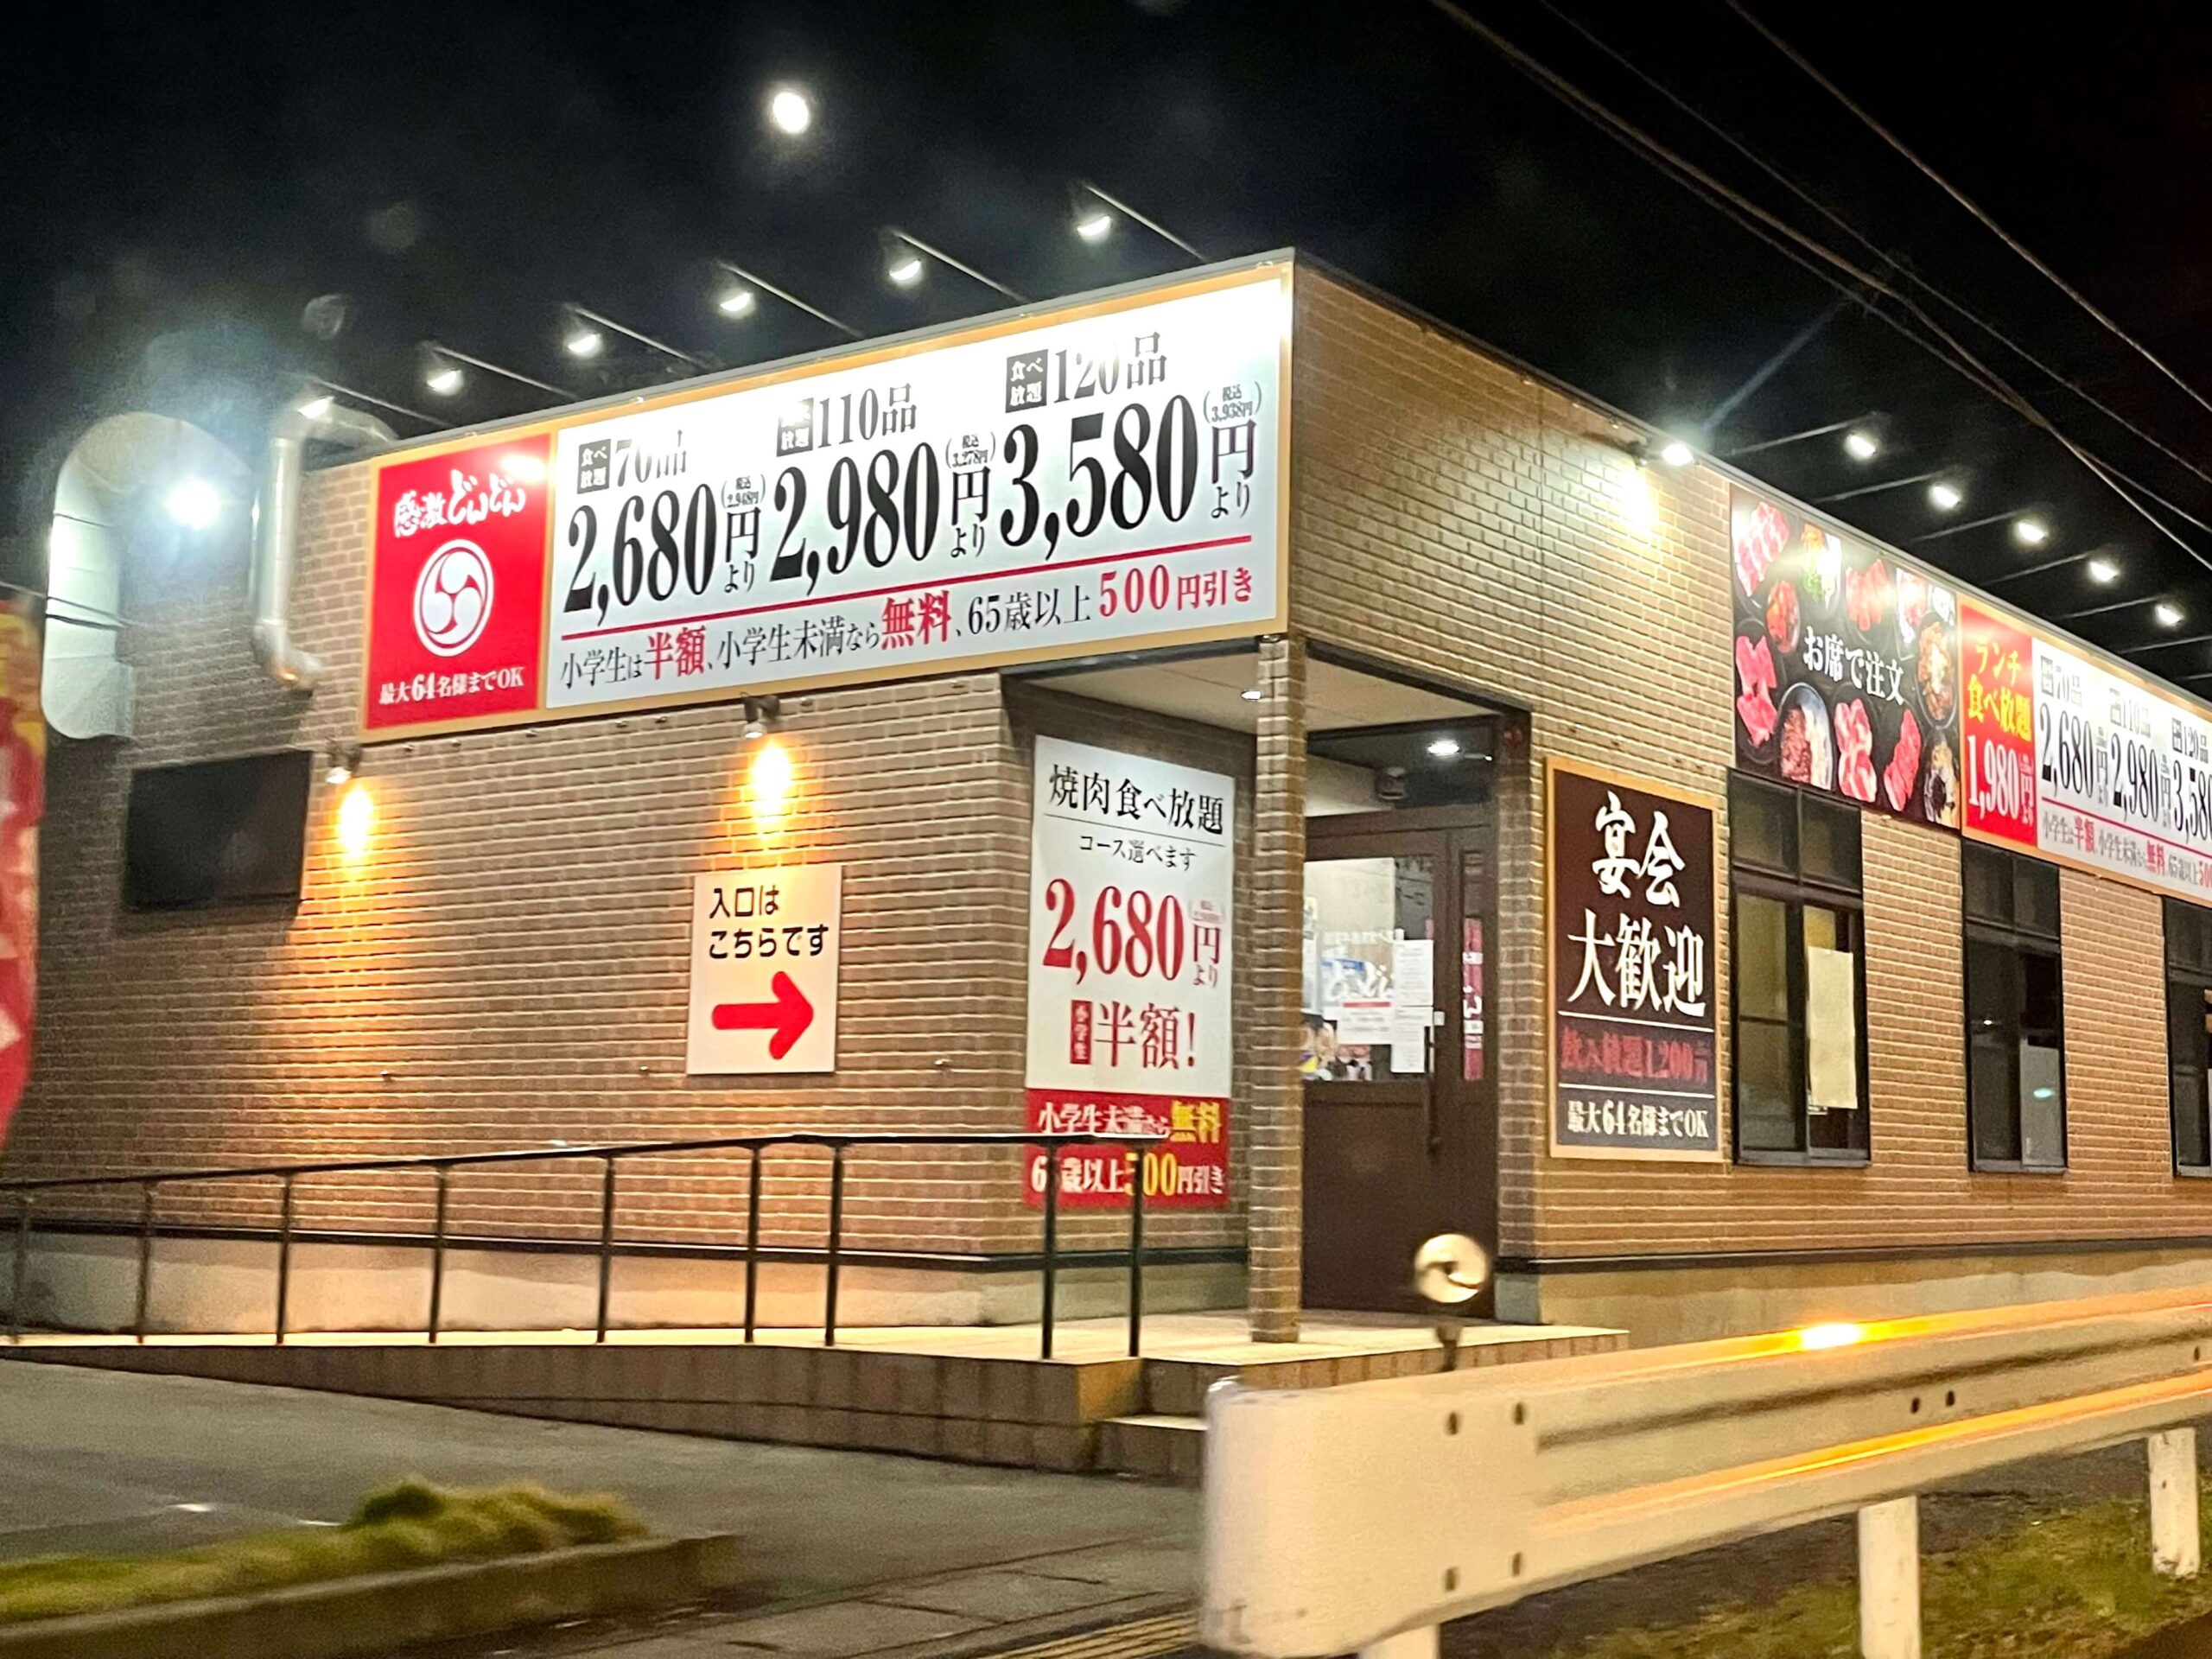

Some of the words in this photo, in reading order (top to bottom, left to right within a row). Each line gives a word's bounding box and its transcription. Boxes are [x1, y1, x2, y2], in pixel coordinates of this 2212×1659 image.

[1053, 331, 1166, 404] 120品
[818, 383, 917, 448] 110品
[379, 666, 524, 705] 最大64名様までOK
[1803, 626, 1904, 705] お席で注文
[1975, 642, 2022, 687] ランチ
[1967, 673, 2031, 742] 食べ放題
[1048, 765, 1224, 836] 焼肉食べ放題
[1079, 833, 1197, 872] コース選べます
[1592, 791, 1686, 908] 宴会
[709, 885, 779, 919] 入口は
[709, 924, 829, 959] こちらです
[1567, 908, 1707, 1018] 大歓迎
[1567, 1099, 1708, 1138] 最大64名様までOK
[1032, 1153, 1224, 1196] 6歳以上500円引き
